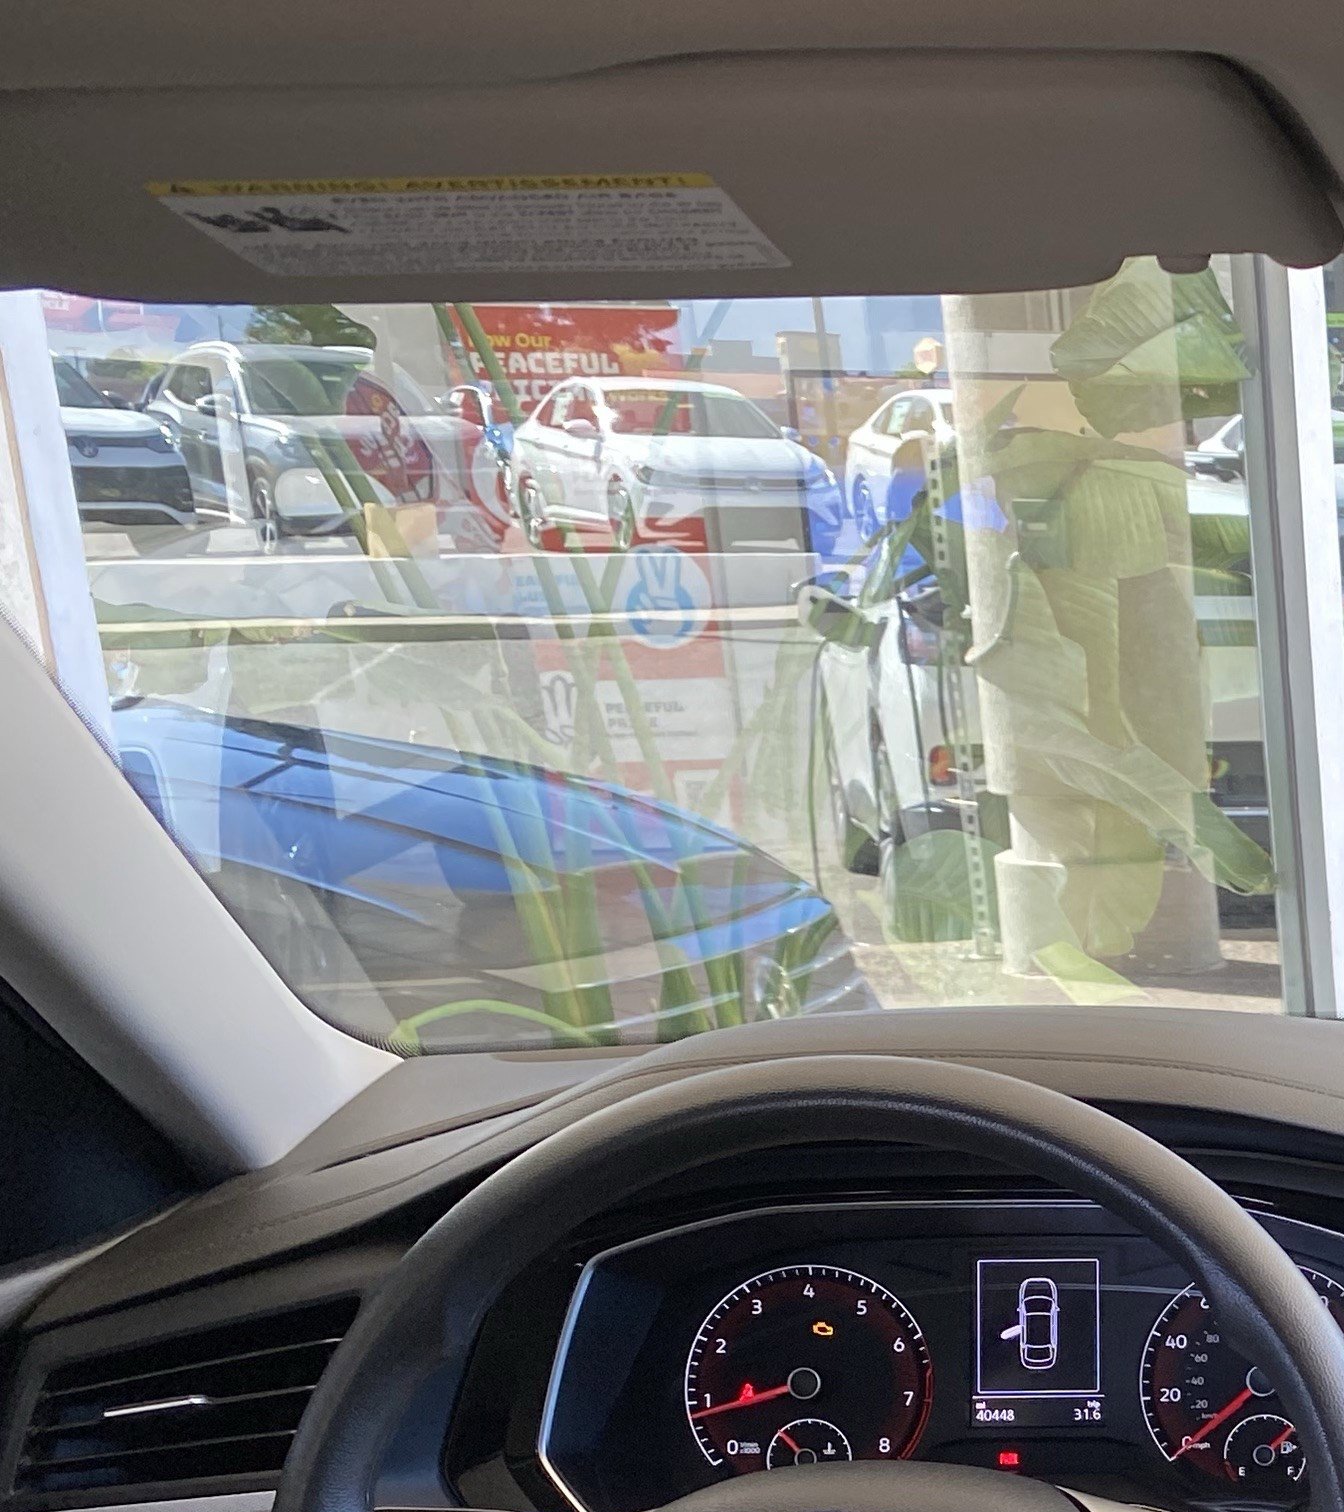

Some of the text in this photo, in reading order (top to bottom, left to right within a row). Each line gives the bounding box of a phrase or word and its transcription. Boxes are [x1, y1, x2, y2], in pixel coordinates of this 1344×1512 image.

[803, 1283, 815, 1298] 4
[751, 1299, 763, 1314] 3
[856, 1300, 867, 1315] 5
[715, 1338, 727, 1354] 2
[893, 1337, 905, 1353] 6
[1164, 1334, 1188, 1350] 40
[703, 1393, 711, 1408] 1
[903, 1391, 914, 1406] 7
[1159, 1388, 1182, 1403] 20
[975, 1409, 1015, 1421] 40448
[1073, 1408, 1101, 1421] 31.6
[727, 1439, 739, 1455] 0
[878, 1437, 890, 1453] 8
[1237, 1466, 1246, 1477] E
[1286, 1466, 1295, 1477] F
